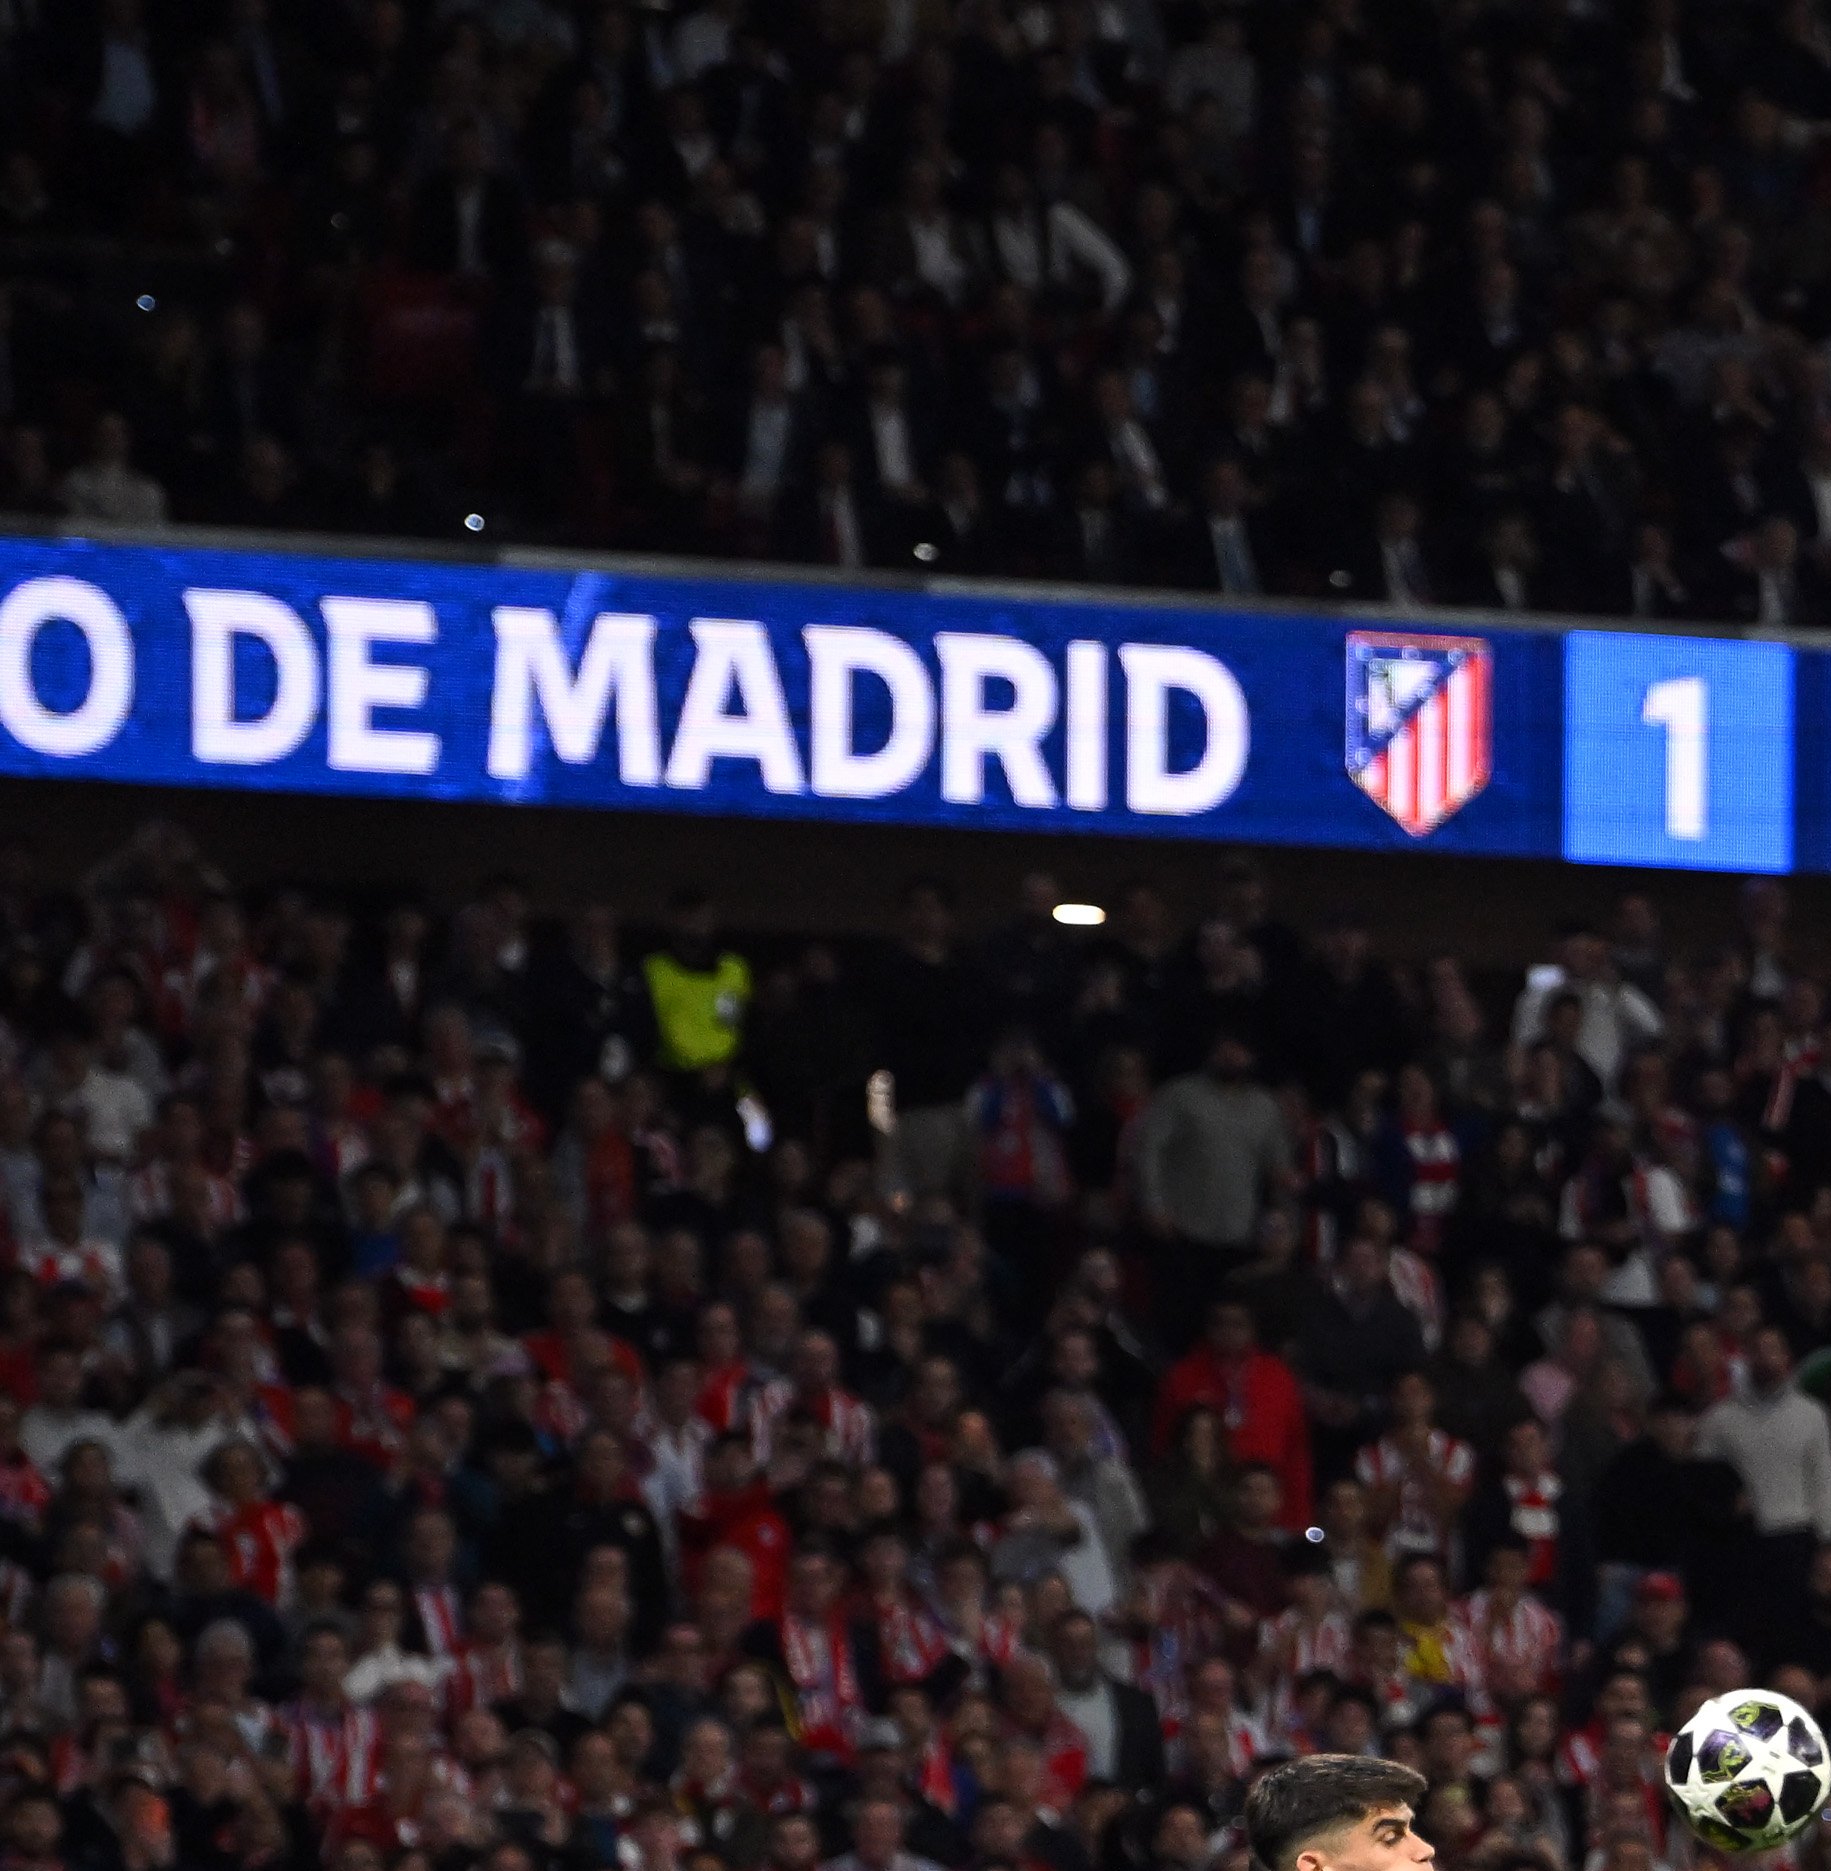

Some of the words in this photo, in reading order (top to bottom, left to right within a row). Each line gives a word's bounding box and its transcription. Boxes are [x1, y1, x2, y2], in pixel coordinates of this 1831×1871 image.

[0, 576, 134, 757] O
[186, 588, 440, 774] DE
[487, 607, 1250, 814] MADRID
[1642, 677, 1707, 840] 1
